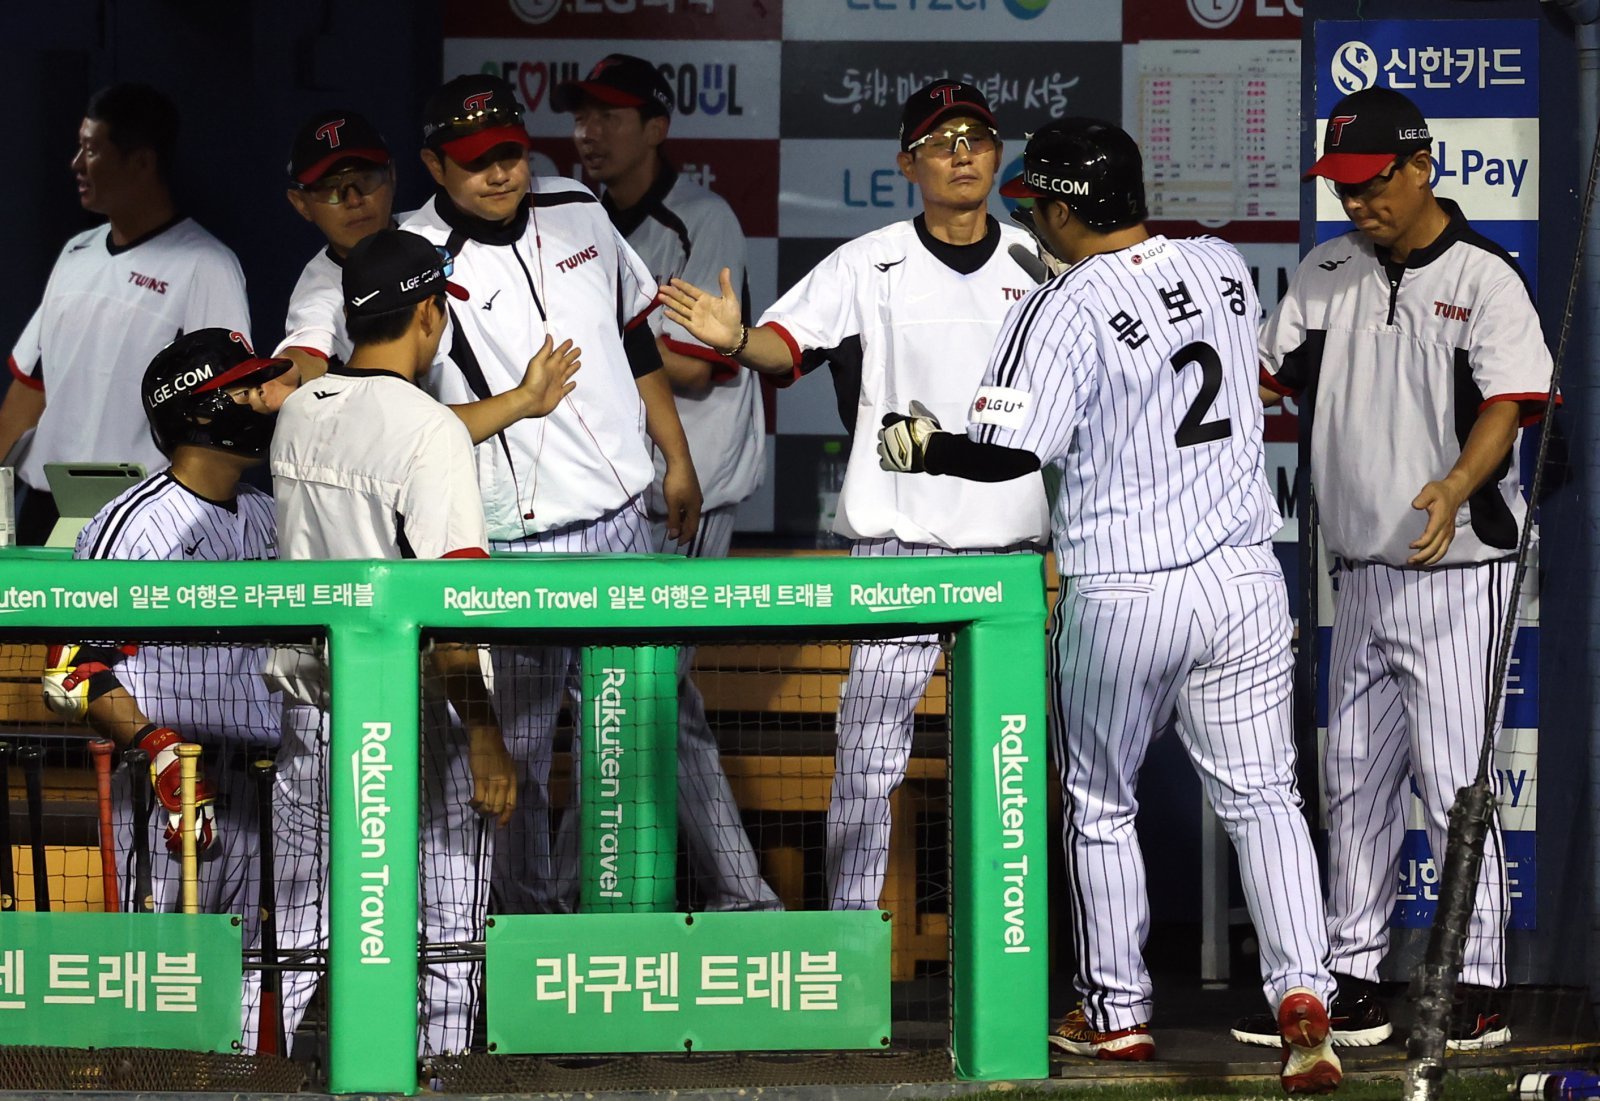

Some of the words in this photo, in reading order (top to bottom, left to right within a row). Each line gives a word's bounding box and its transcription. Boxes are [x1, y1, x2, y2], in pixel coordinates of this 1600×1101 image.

[1384, 46, 1526, 89] 신한카드
[1024, 71, 1080, 119] 서울
[1399, 127, 1431, 140] LGE.CO
[1027, 171, 1089, 196] LGE.COM
[1461, 150, 1529, 197] Pay
[556, 245, 598, 274] TWINS
[128, 271, 168, 294] TWINS
[149, 364, 213, 408] LGE.COM
[987, 399, 1002, 410] LG
[1170, 341, 1232, 448] 2
[0, 586, 46, 608] uten
[50, 587, 118, 609] Travel
[130, 585, 170, 609] 일본
[177, 585, 237, 609] 여행은
[245, 584, 305, 608] 라쿠텐
[312, 583, 374, 607] 트래블
[444, 586, 530, 609] Rakuten
[535, 586, 597, 609] Travel
[608, 585, 646, 609] 일본
[651, 584, 708, 609] 여행은
[714, 584, 770, 608] 라쿠텐
[776, 583, 833, 607] 트래블
[850, 582, 936, 606] Rakuten
[940, 581, 1002, 604] Travel
[601, 668, 626, 797] Rakuten
[361, 722, 392, 858] Rakuten
[1000, 714, 1029, 849] Rakuten
[600, 804, 623, 897] Travel
[360, 864, 391, 964] Travel
[1003, 855, 1031, 953] Travel
[44, 951, 202, 1012] 트래블
[536, 952, 679, 1014] 라쿠텐
[696, 951, 842, 1010] 트래블
